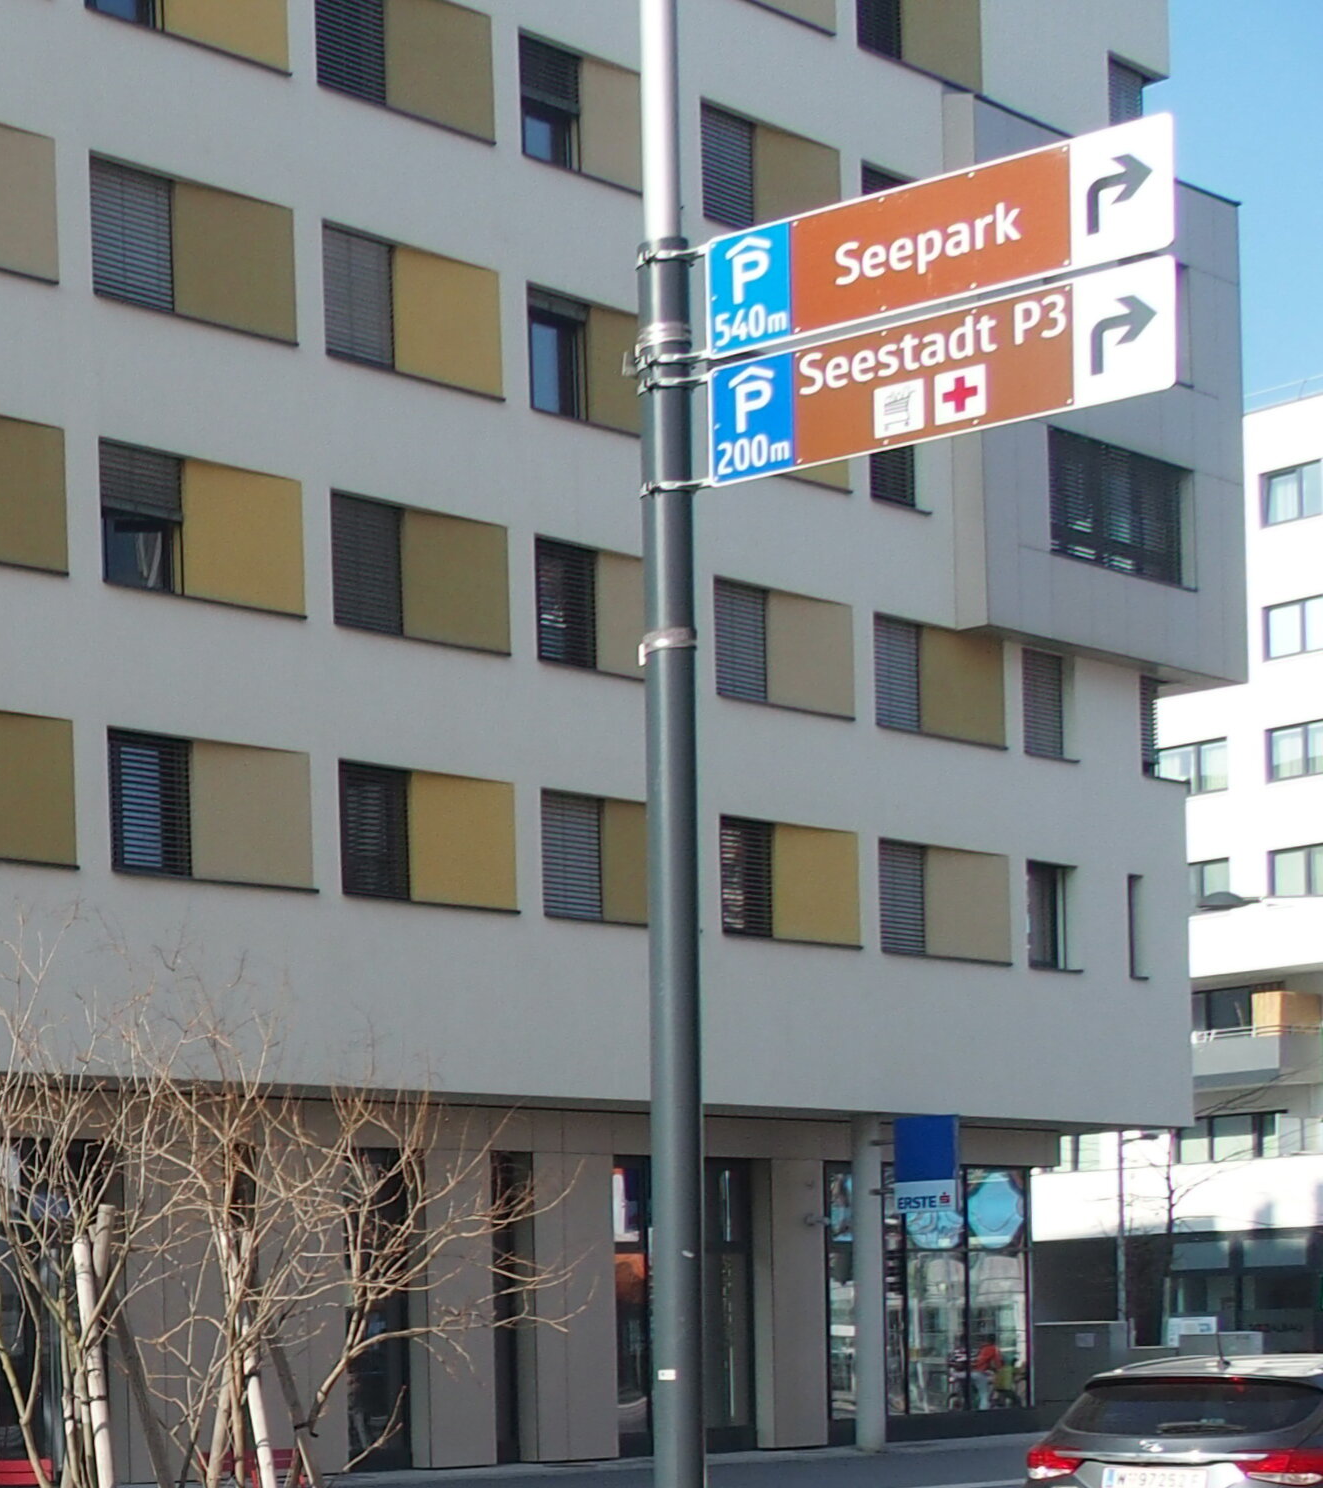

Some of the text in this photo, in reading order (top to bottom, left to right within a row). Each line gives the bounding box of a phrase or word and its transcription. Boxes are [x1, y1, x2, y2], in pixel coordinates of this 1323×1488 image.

[834, 202, 1022, 286] Seepark
[714, 303, 787, 347] 540m
[798, 293, 1067, 396] Seestadt P3
[717, 433, 790, 475] 200m
[898, 1196, 937, 1210] ERSTE
